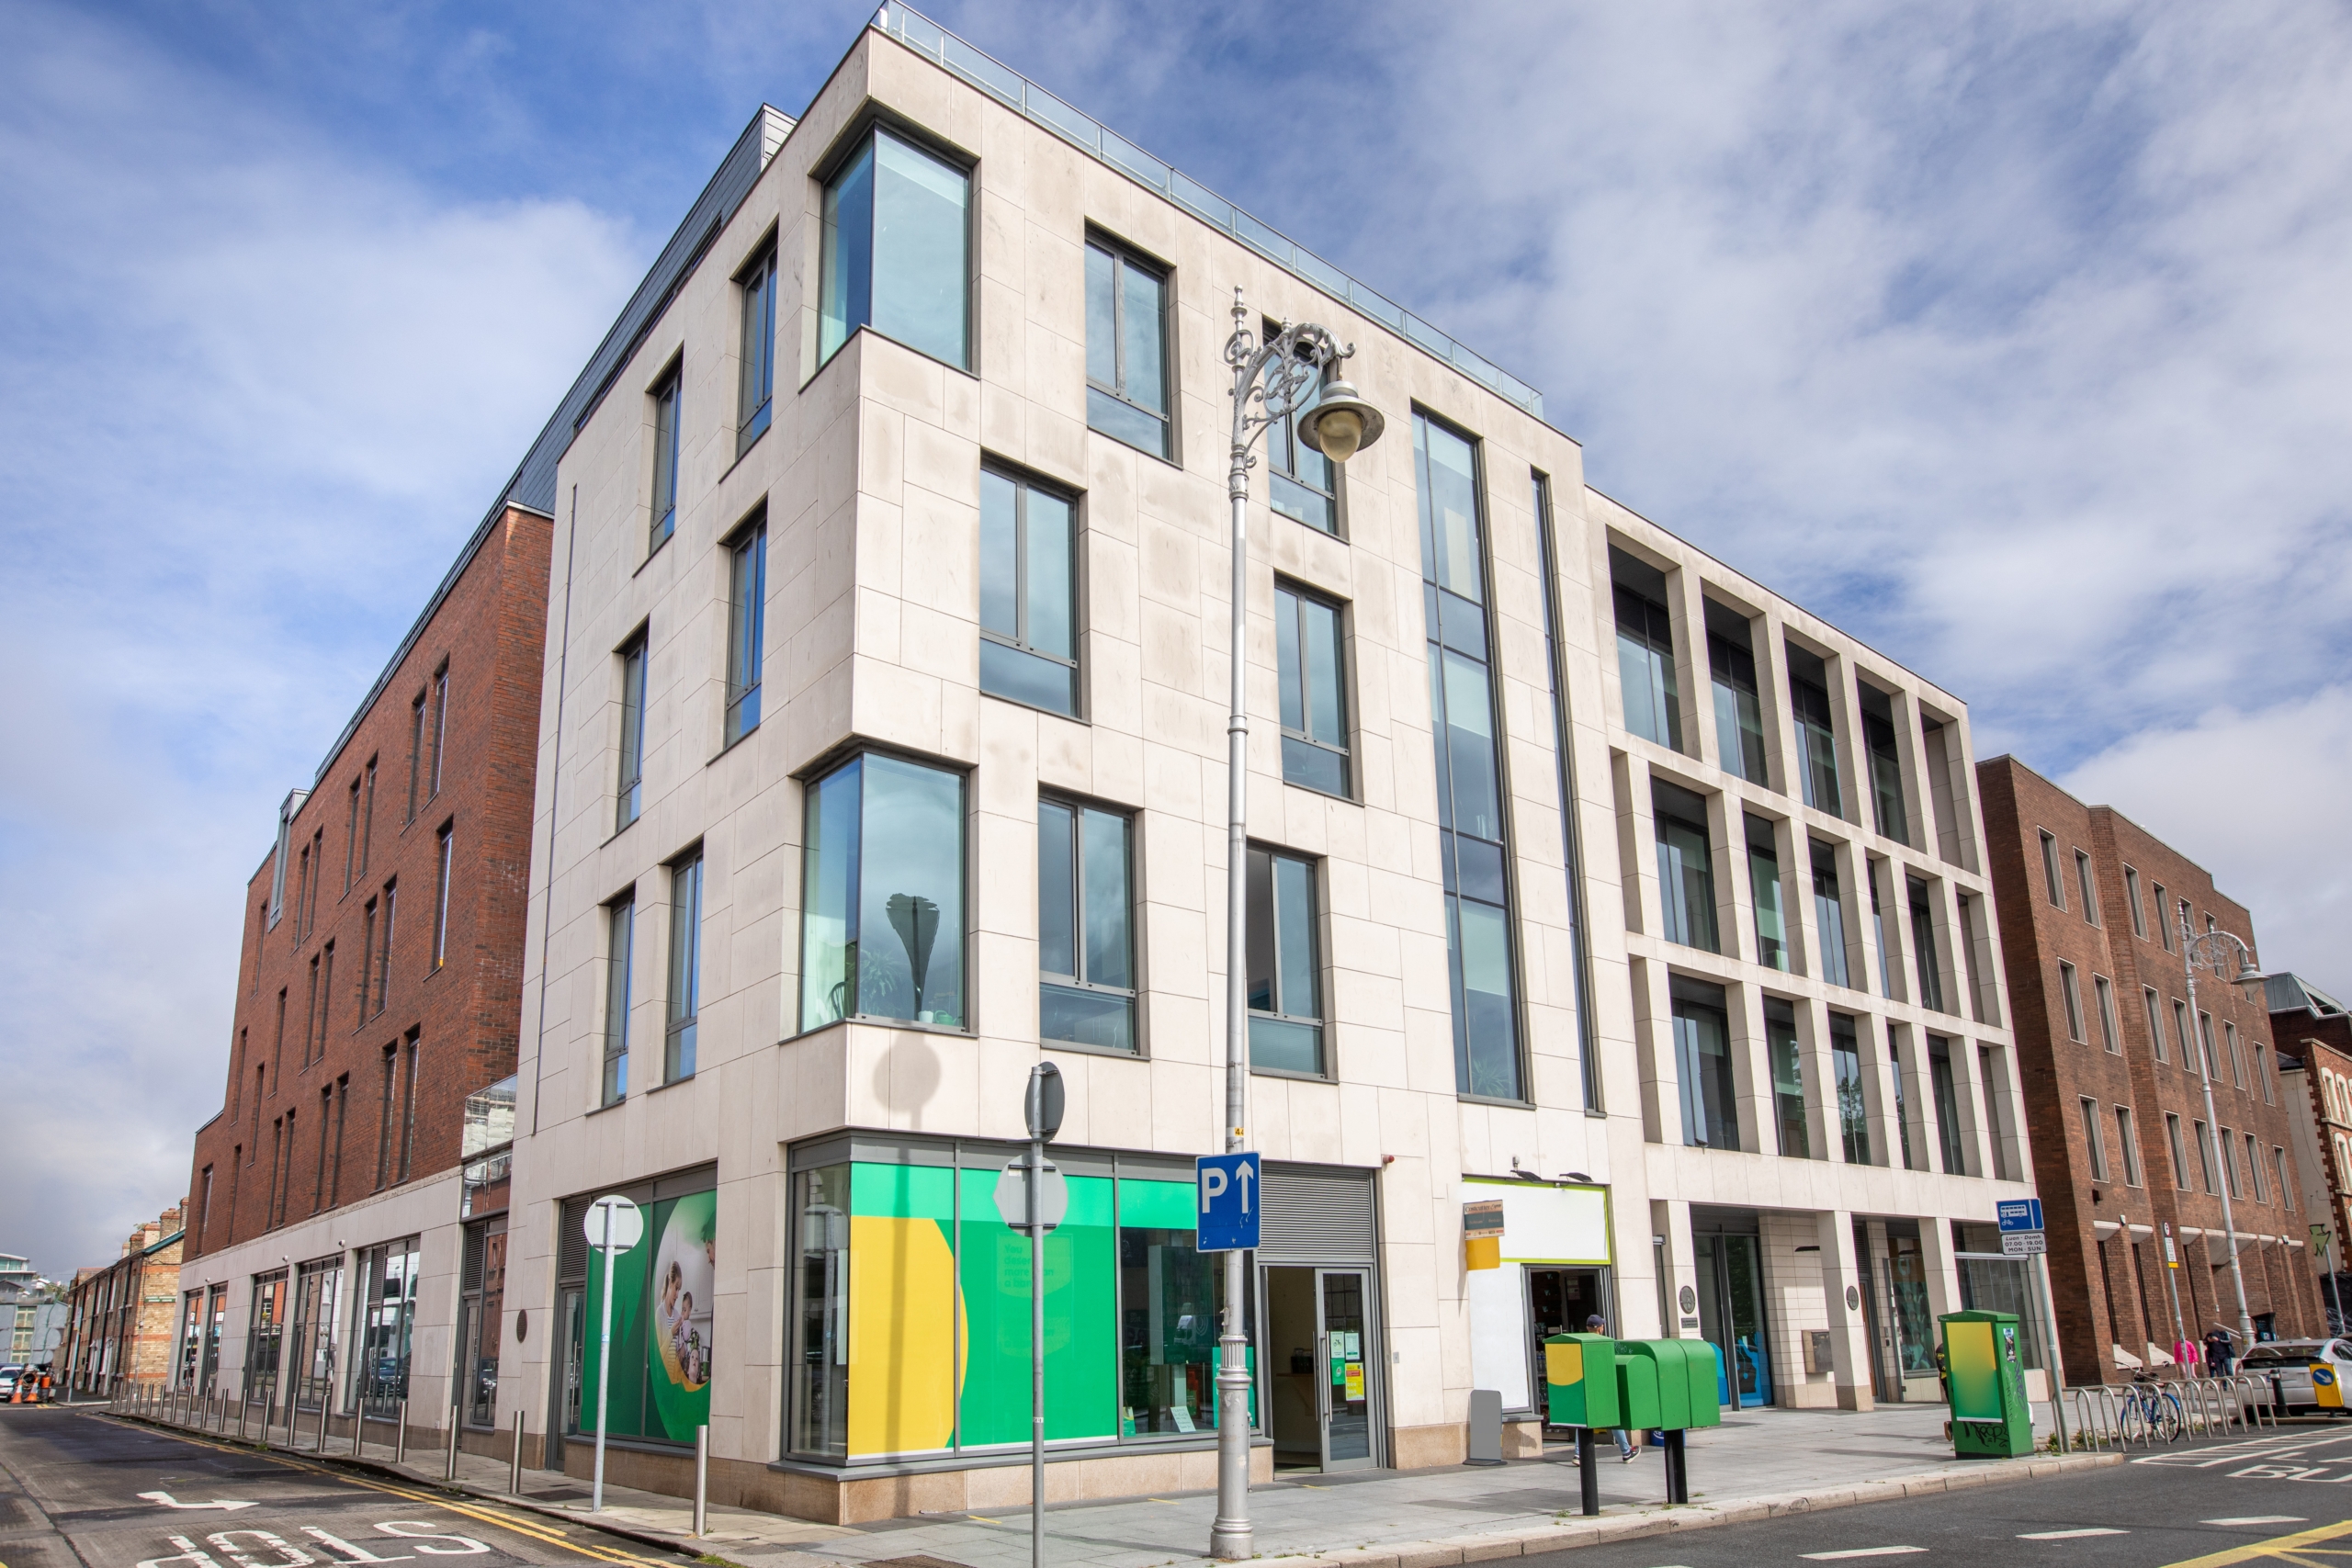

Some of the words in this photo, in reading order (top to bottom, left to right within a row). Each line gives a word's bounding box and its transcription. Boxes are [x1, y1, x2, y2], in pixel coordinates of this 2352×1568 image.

[1201, 1168, 1228, 1213] P
[1004, 1244, 1023, 1254] You
[1004, 1256, 1032, 1265] deser
[1013, 1278, 1032, 1288] ban
[136, 1521, 491, 1568] STOP
